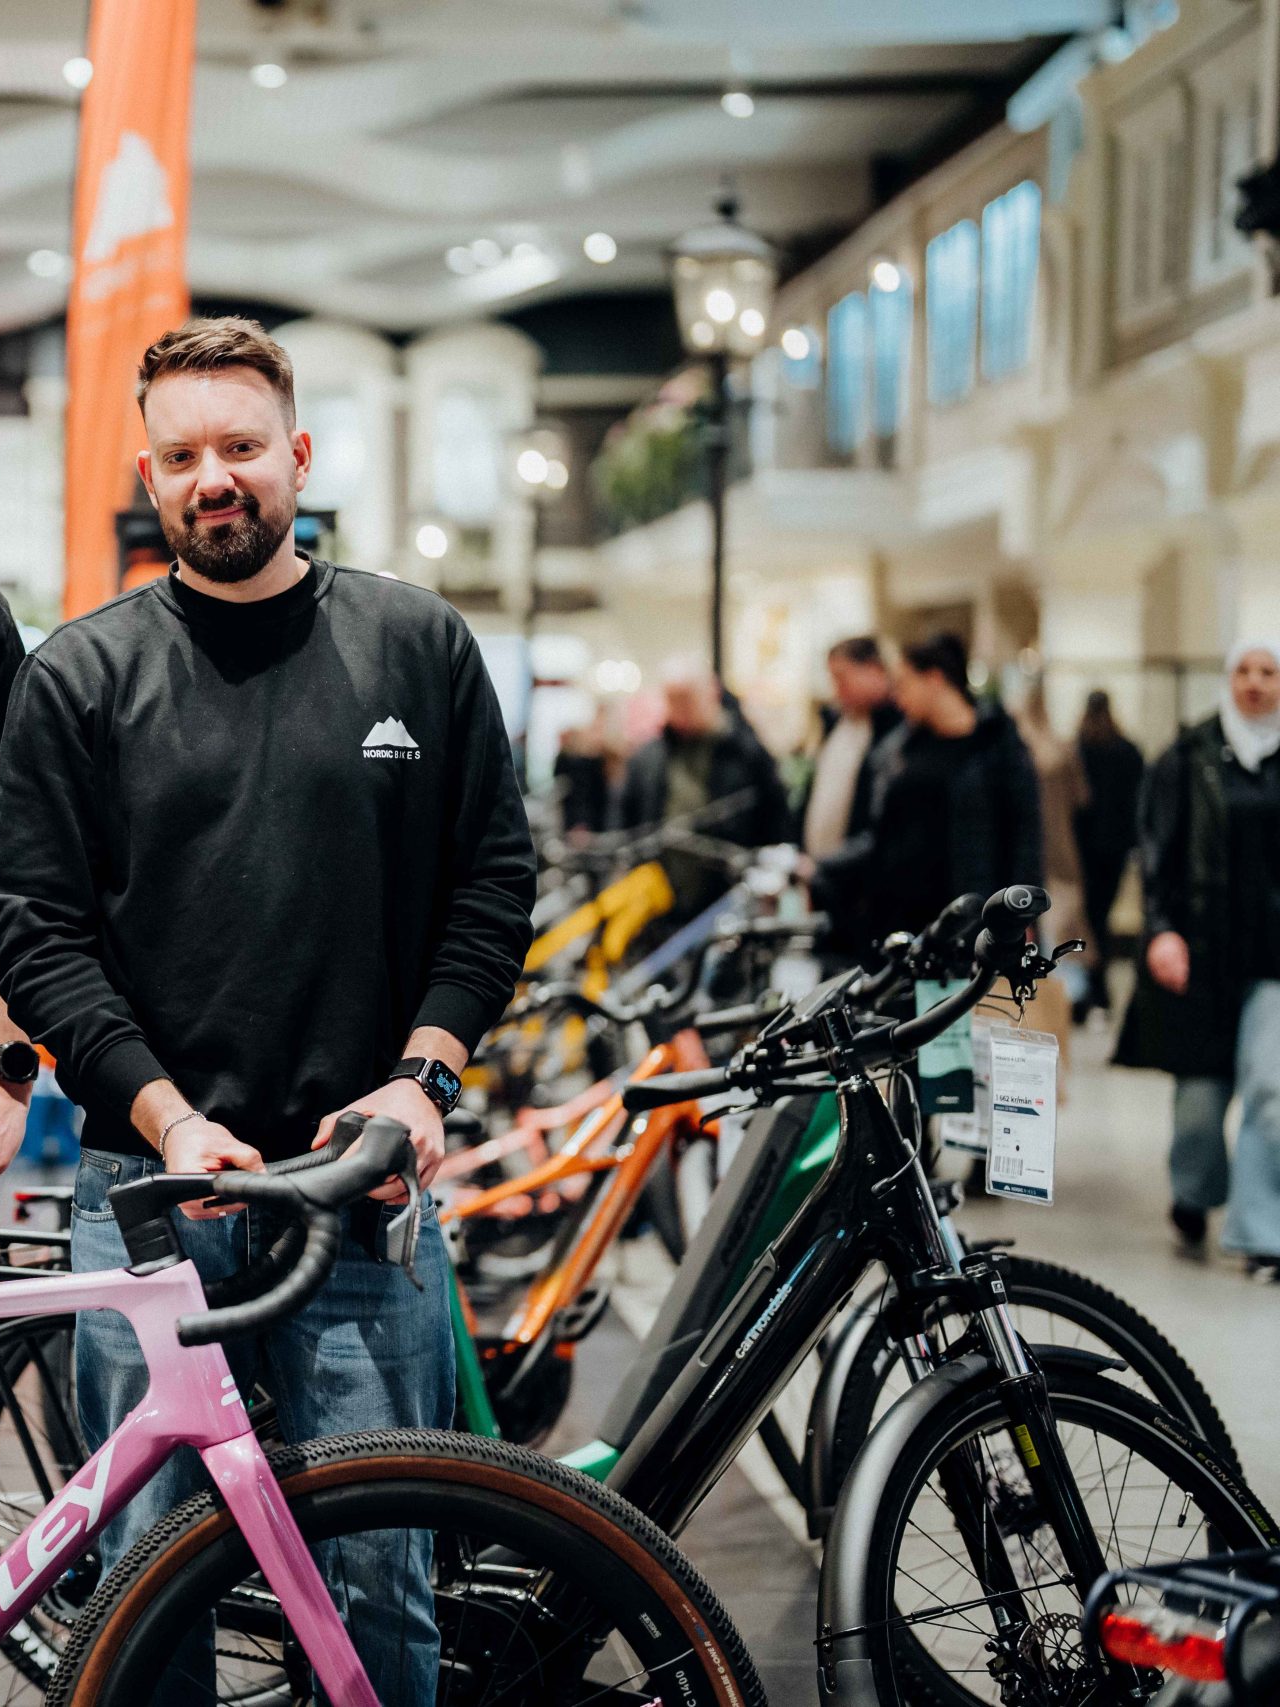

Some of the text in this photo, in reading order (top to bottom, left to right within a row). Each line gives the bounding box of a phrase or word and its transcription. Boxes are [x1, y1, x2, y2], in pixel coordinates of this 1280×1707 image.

[363, 749, 421, 760] NORDIC BIKES
[735, 1283, 792, 1359] cannondale
[675, 1670, 693, 1697] 1400
